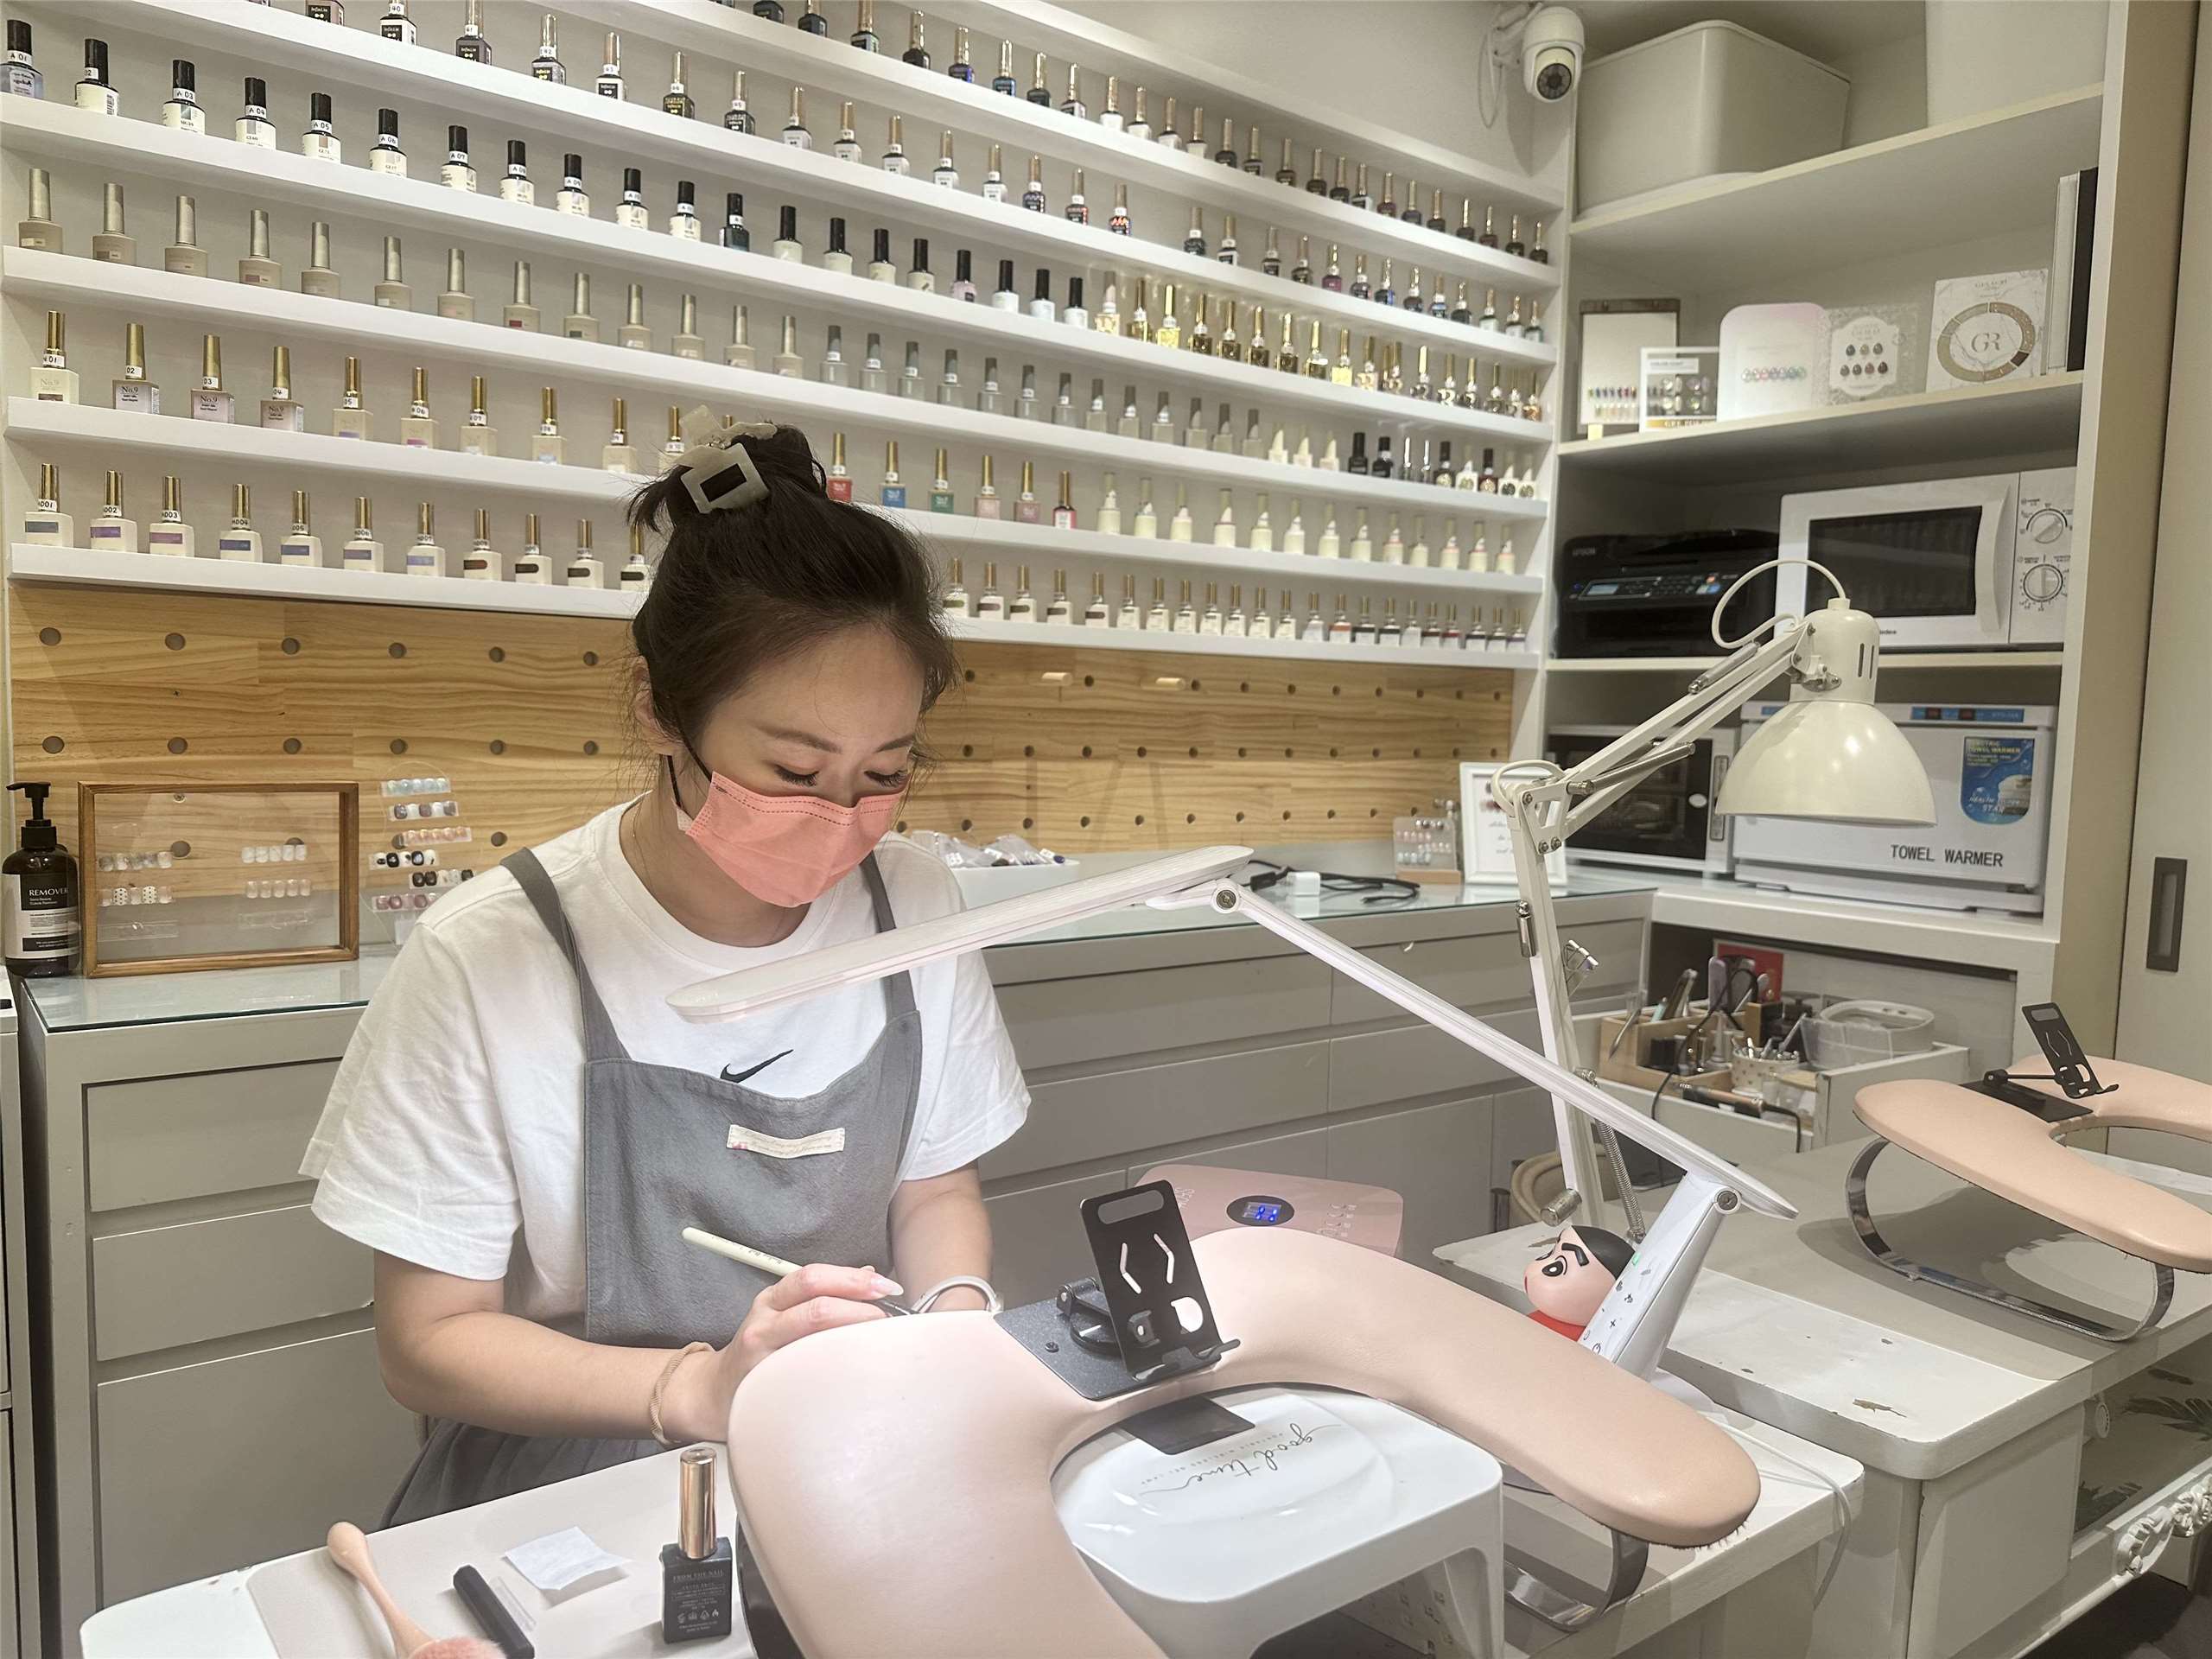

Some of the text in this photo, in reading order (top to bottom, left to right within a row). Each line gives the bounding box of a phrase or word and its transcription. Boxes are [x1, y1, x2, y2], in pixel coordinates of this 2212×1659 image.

[321, 122, 330, 130] 05
[1891, 843, 2004, 868] TOWEL WARMER
